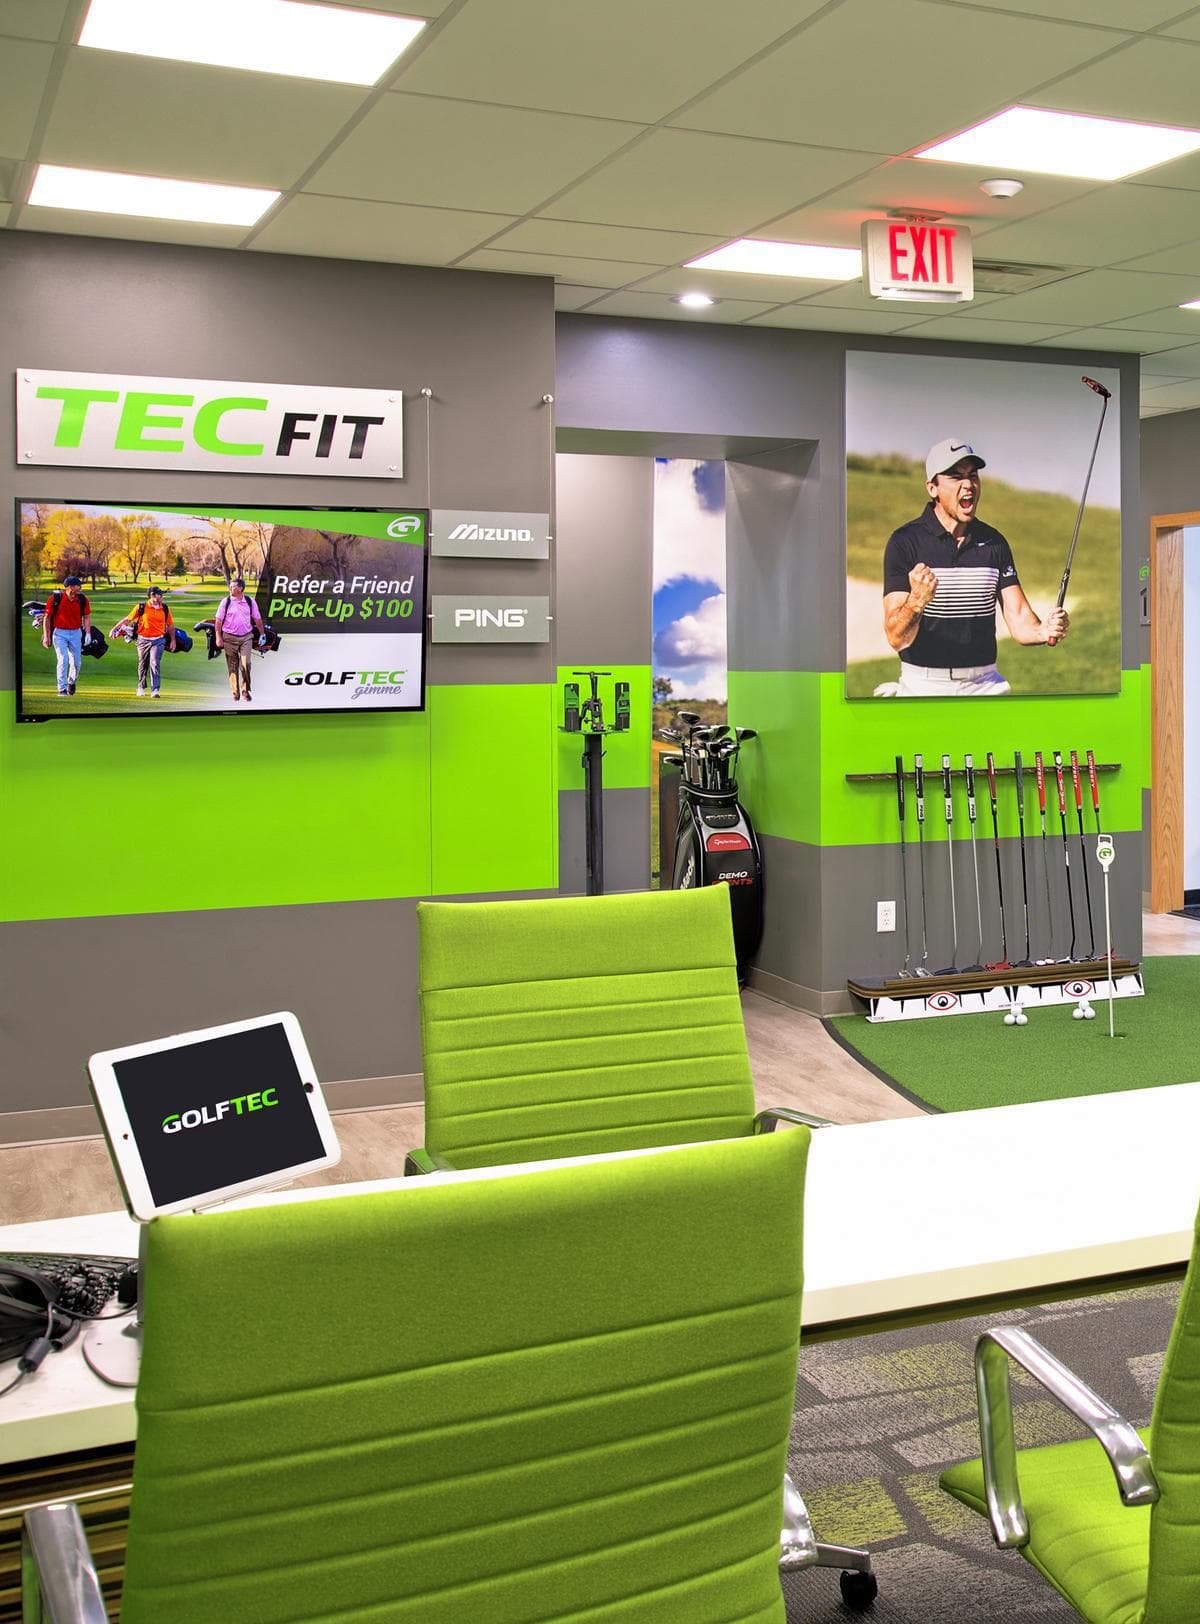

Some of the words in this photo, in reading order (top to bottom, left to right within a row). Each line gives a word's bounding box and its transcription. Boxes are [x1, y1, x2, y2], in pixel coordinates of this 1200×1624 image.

[888, 223, 958, 284] EXIT
[35, 386, 269, 457] TEC
[275, 411, 385, 460] FIT
[273, 575, 329, 594] Refer
[332, 581, 345, 594] a
[350, 575, 415, 594] Friend
[268, 597, 354, 622] Pick-Up
[359, 596, 414, 620] $100
[284, 670, 407, 686] GOLFTEC
[350, 682, 403, 700] gimme
[718, 871, 748, 880] DEMO
[162, 1087, 279, 1134] GOLFTEC
